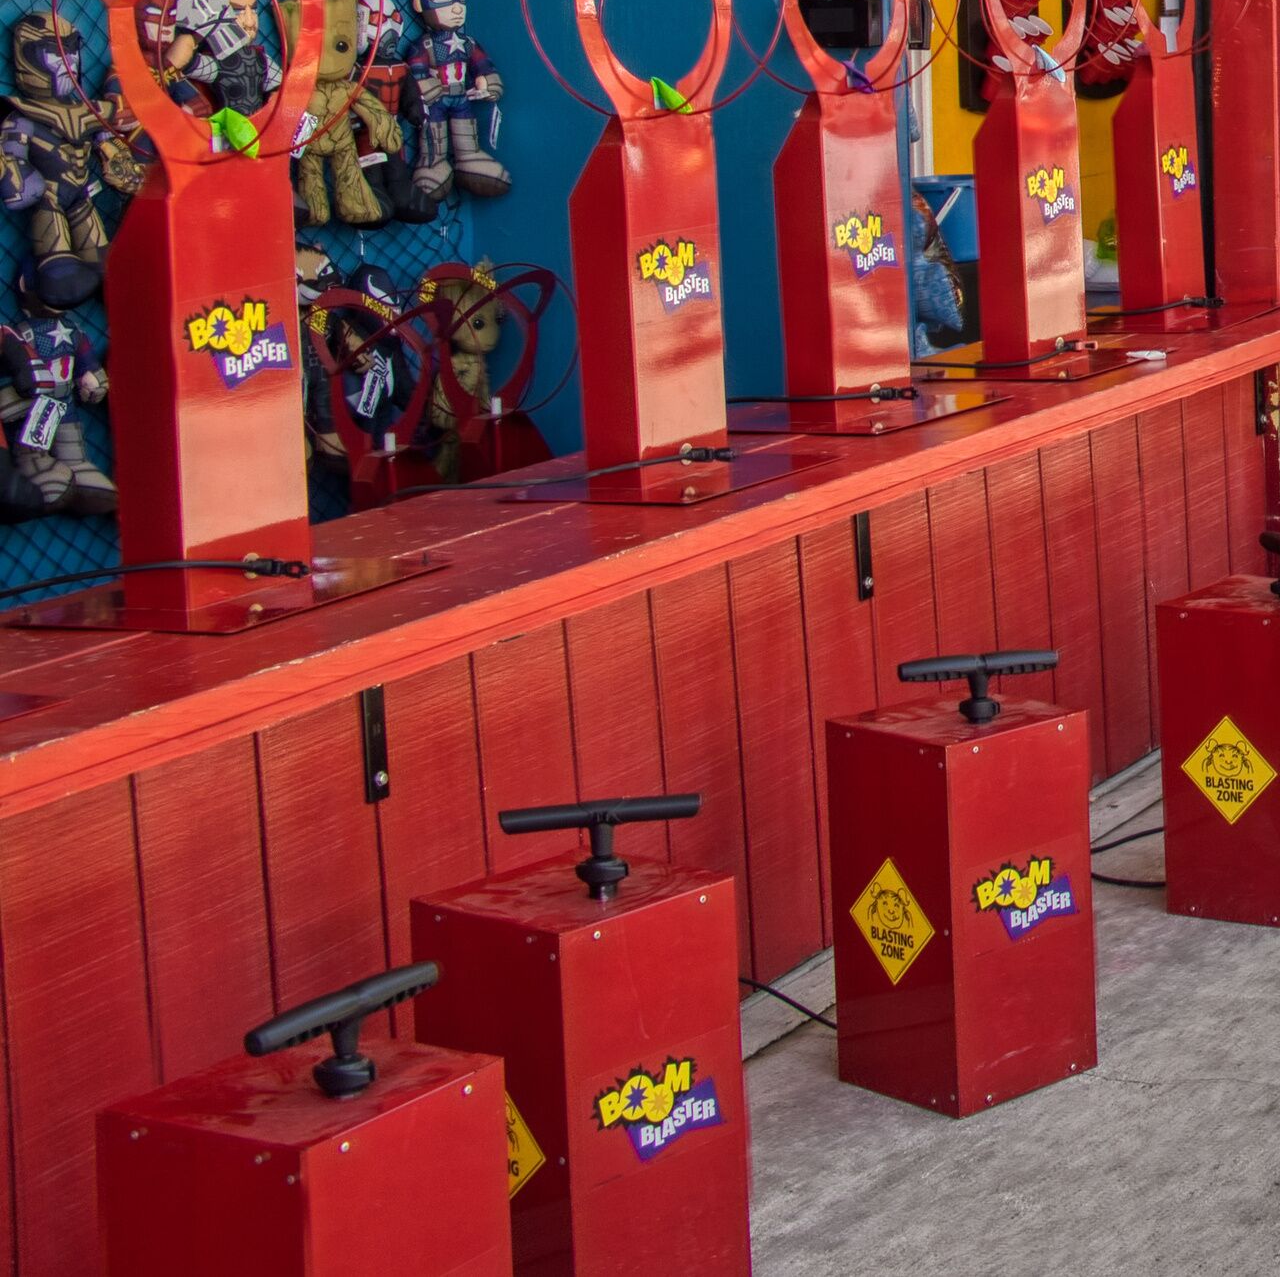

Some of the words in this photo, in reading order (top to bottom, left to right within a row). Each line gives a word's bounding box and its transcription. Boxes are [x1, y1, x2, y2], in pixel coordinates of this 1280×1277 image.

[1161, 147, 1188, 179] BOOM
[1027, 168, 1064, 203] BOOM
[1173, 169, 1196, 193] BLASTER
[1044, 194, 1074, 218] BLASTER
[835, 214, 881, 254] BOOM
[640, 242, 694, 286] BOOM
[856, 243, 895, 272] BLASTER
[665, 273, 709, 305] BLASTER
[188, 302, 265, 355] BOOM
[225, 338, 287, 378] BLASTER
[1205, 776, 1254, 791] BLASTING
[1216, 789, 1244, 803] ZONE
[977, 860, 1050, 909] BOOM
[1010, 890, 1071, 929] BLASTER
[870, 925, 914, 949] BLASTING
[880, 942, 905, 961] ZONE
[599, 1061, 690, 1127] BOOM
[640, 1097, 716, 1147] BLASTER
